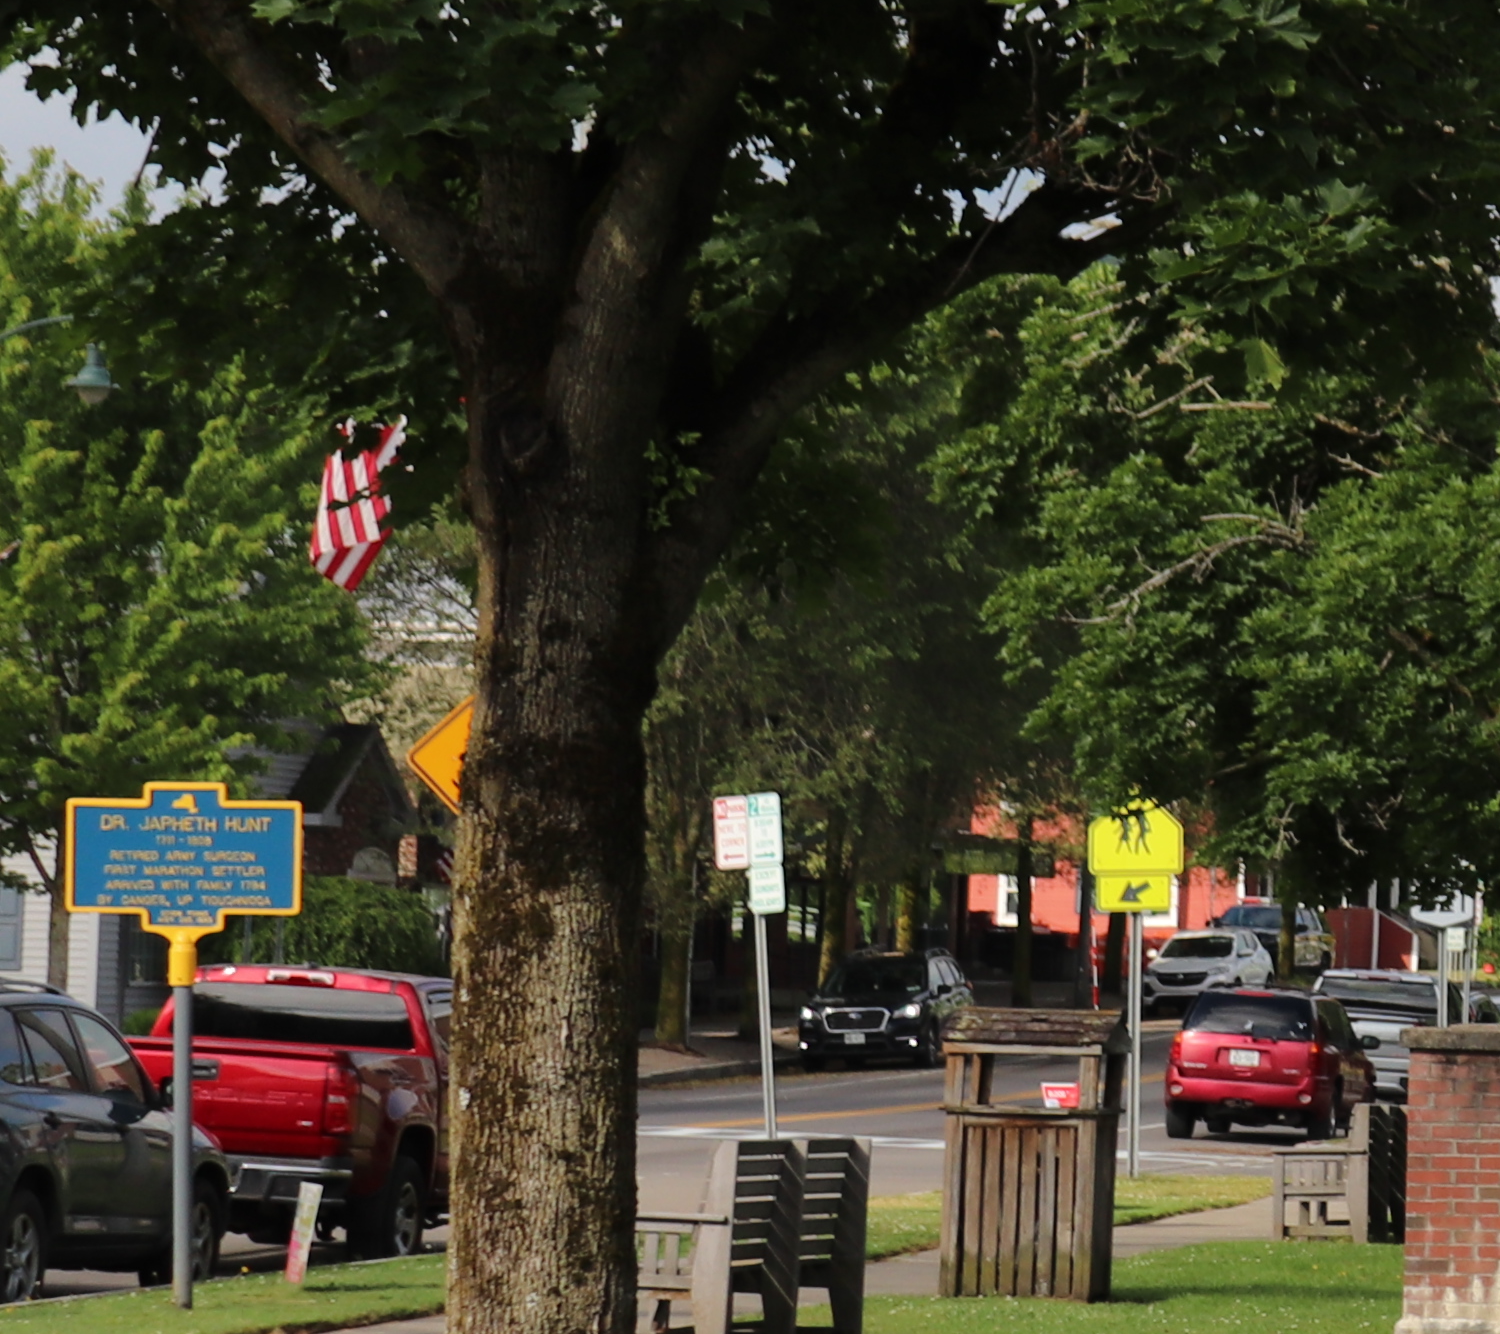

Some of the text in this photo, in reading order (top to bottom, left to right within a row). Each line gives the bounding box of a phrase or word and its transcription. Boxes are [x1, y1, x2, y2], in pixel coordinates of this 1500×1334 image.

[101, 814, 272, 832] DR. JAPHETH HUNT
[110, 850, 256, 862] RETIRED ARMY SURGEON
[104, 865, 265, 876] FIRST MARATHON SETTLER
[105, 880, 155, 890] ARRIVED
[161, 880, 189, 891] WITH
[196, 881, 233, 891] FAMILY
[97, 895, 113, 905] BY
[121, 895, 171, 907] CANOES,
[177, 896, 194, 906] UP
